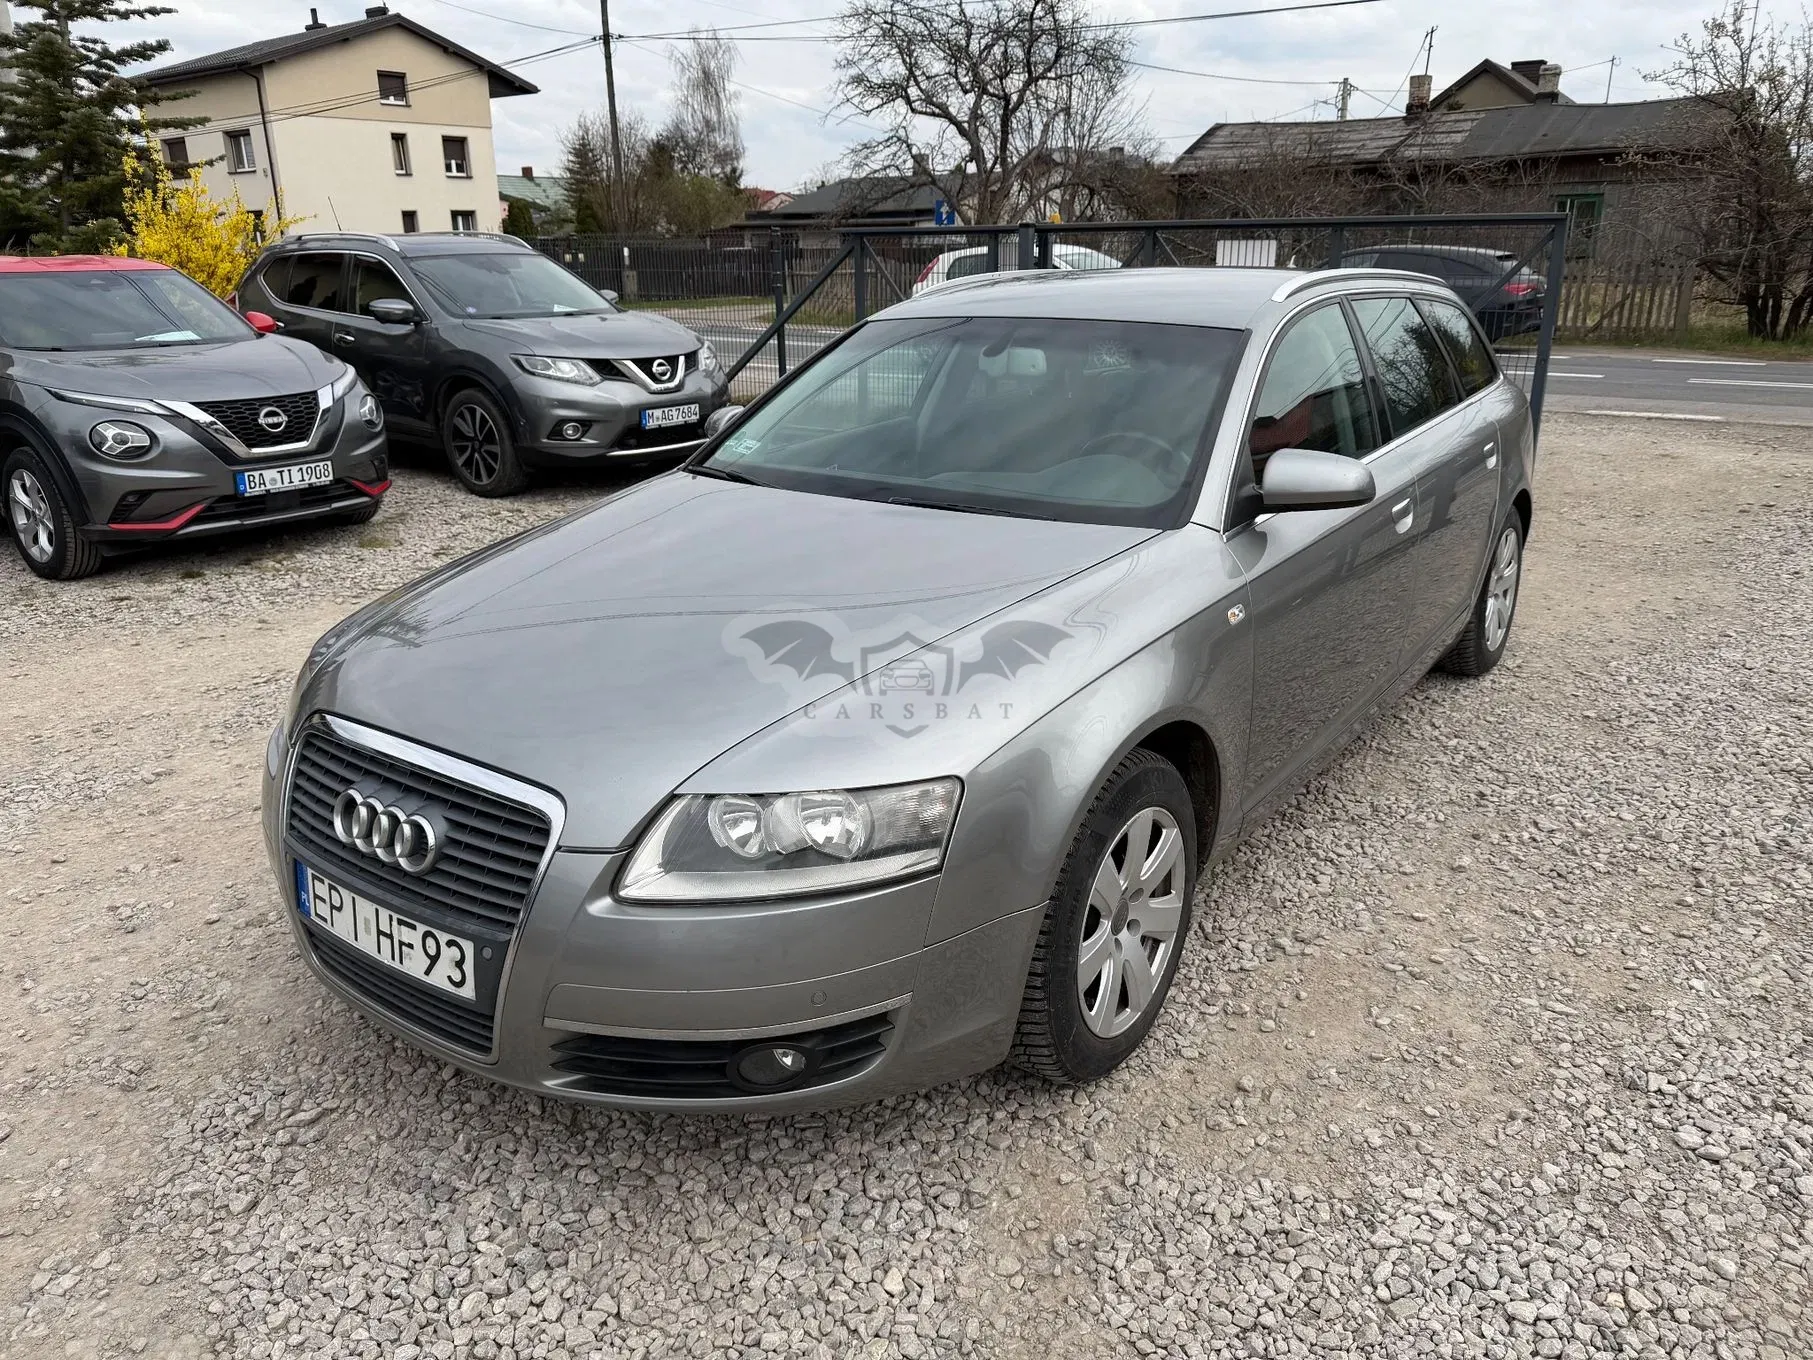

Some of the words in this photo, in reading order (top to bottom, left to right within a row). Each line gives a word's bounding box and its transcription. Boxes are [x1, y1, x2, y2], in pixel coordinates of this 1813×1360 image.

[647, 411, 654, 424] M
[661, 408, 673, 422] AG
[675, 405, 698, 420] 7684
[247, 473, 267, 490] BA
[277, 469, 294, 486] TI
[297, 463, 330, 482] 1908
[301, 890, 310, 906] PL
[311, 872, 359, 942] EPI
[375, 907, 466, 988] HF93
